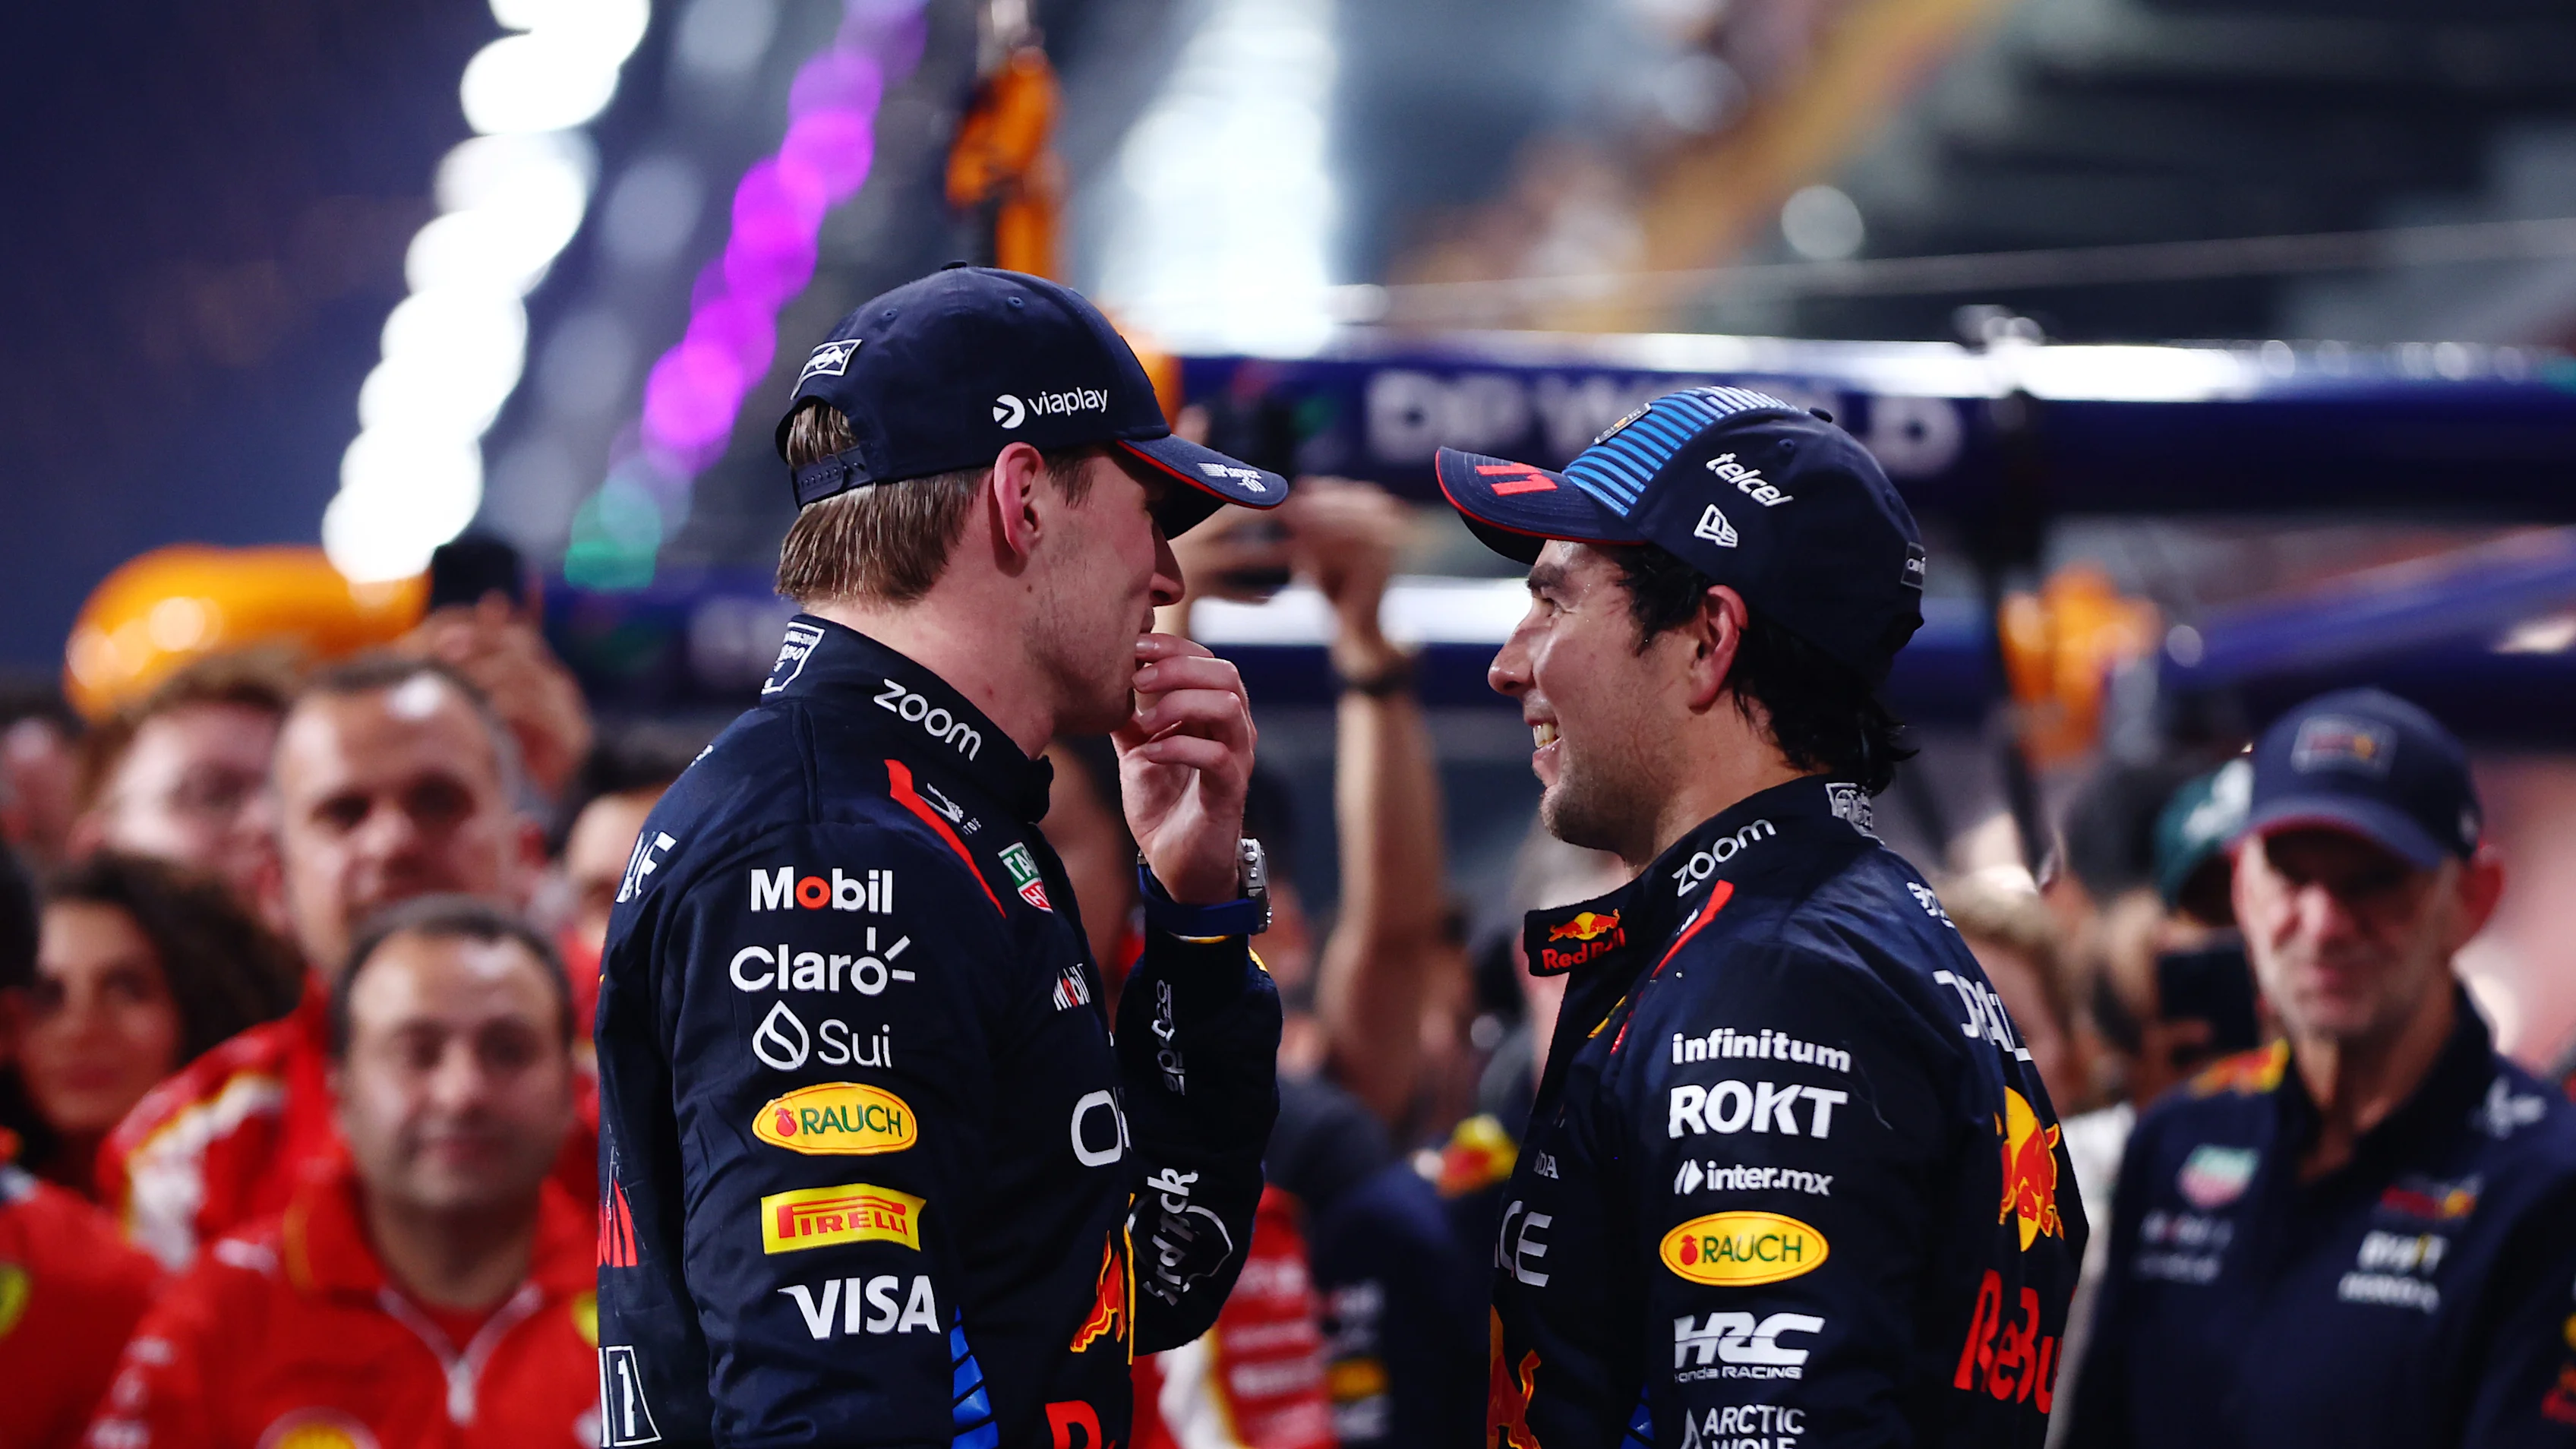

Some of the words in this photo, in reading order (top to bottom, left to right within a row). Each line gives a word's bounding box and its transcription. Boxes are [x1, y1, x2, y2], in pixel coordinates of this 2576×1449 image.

[1028, 387, 1107, 416] viaplay
[1706, 453, 1794, 507] telcel
[873, 678, 982, 761] zoom
[1672, 819, 1777, 897] zoom
[750, 866, 893, 914] Mobil
[729, 943, 888, 996] Claro
[1542, 942, 1588, 970] Red
[817, 1019, 892, 1069] Sui
[1672, 1028, 1852, 1073] infinitum
[801, 1104, 902, 1138] RAUCH
[1668, 1079, 1848, 1139] ROKT
[1706, 1160, 1834, 1195] inter.mx
[776, 1195, 908, 1239] PIRELLI
[1702, 1235, 1802, 1264] RAUCH
[777, 1275, 942, 1340] VISA
[1674, 1312, 1826, 1369] HRC
[1722, 1365, 1803, 1381] RACING
[1701, 1404, 1807, 1437] ARCTIC
